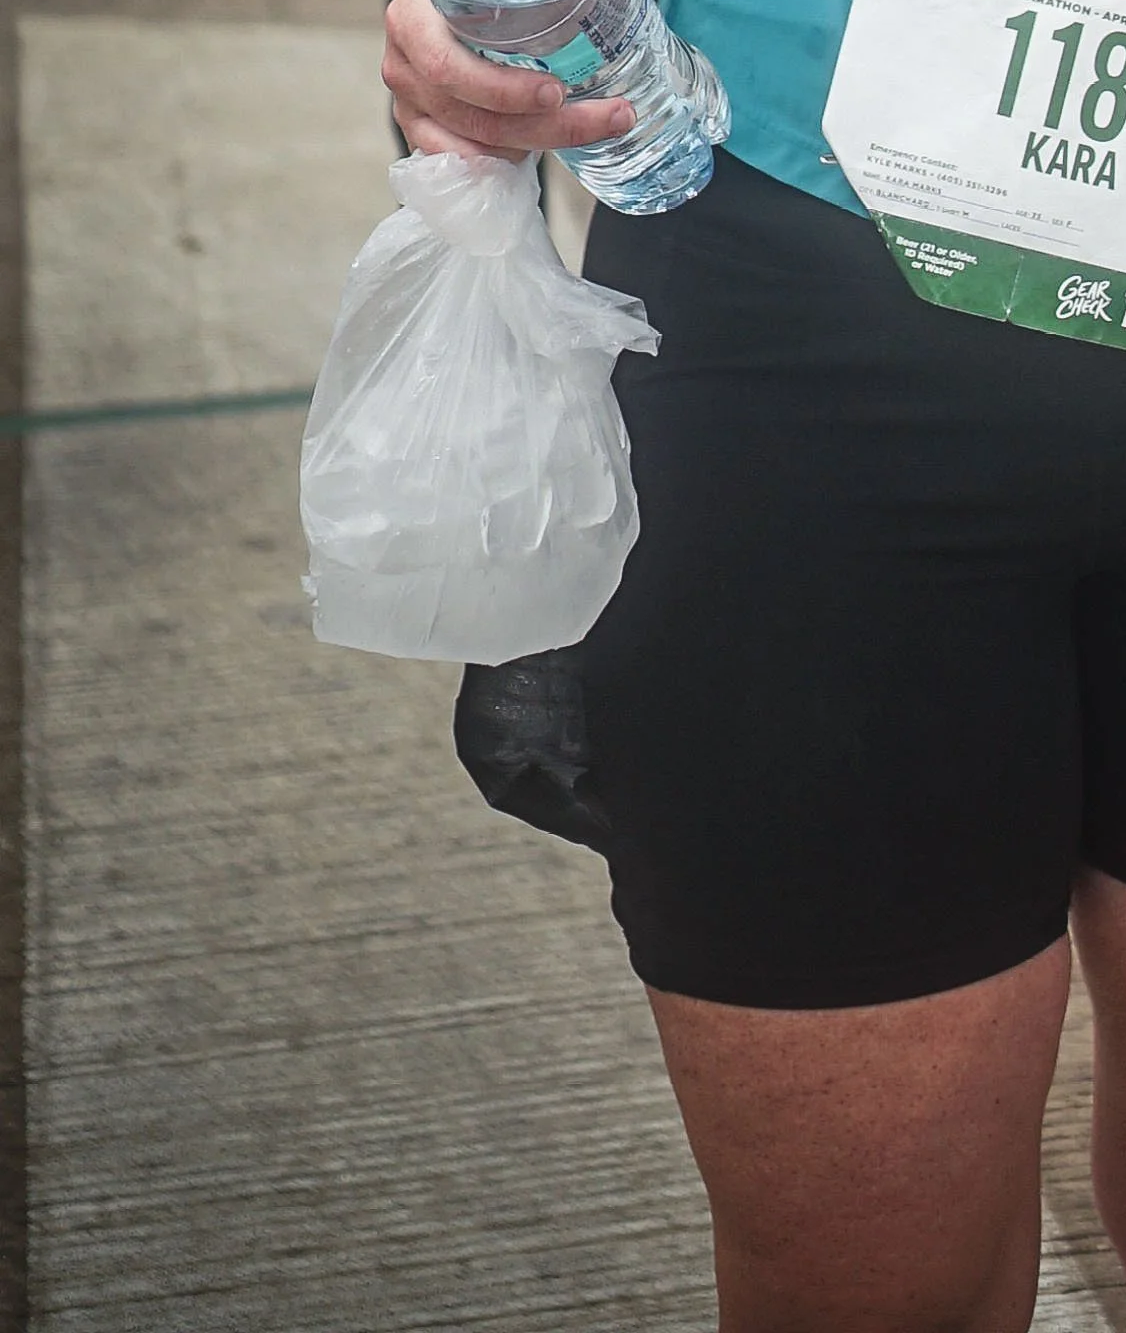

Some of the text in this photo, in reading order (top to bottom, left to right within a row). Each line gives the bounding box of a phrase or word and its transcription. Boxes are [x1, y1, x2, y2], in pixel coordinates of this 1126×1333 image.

[867, 155, 891, 167] KYLE
[893, 162, 927, 177] MARKS
[870, 143, 958, 172] Emergency Contact:
[1021, 131, 1116, 191] KARA
[886, 175, 909, 186] KARA
[912, 183, 942, 195] MARKS
[896, 236, 978, 265] Beer (21 or Older,
[904, 248, 965, 270] ID Required)
[911, 261, 954, 277] or Water
[1057, 275, 1112, 301] GEAR
[1055, 298, 1113, 322] CHECK
